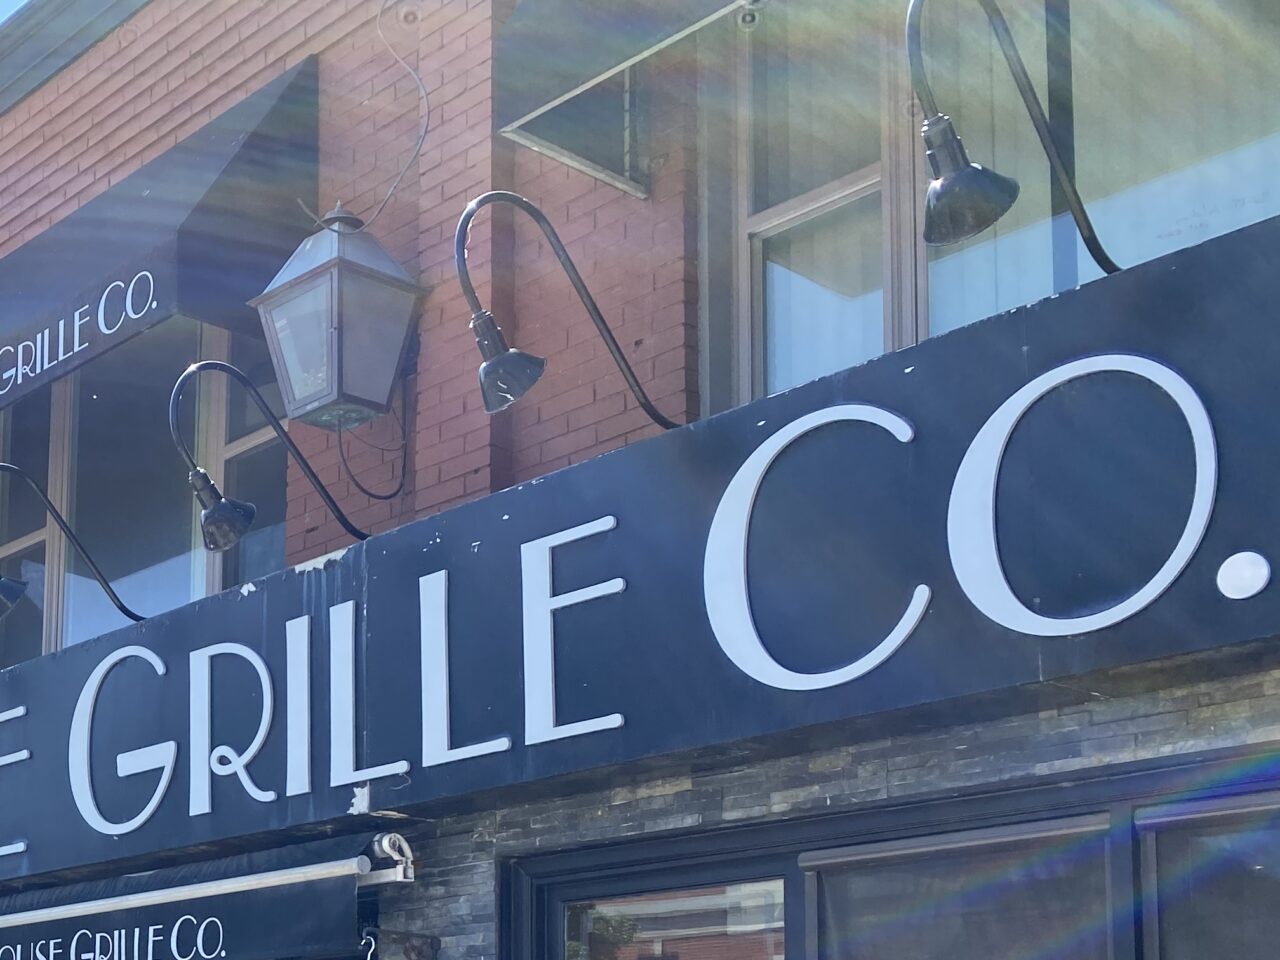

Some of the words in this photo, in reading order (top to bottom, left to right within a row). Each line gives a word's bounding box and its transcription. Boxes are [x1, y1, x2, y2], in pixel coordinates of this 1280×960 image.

[97, 270, 158, 335] CO.
[69, 514, 627, 837] GRILLE
[703, 352, 1273, 693] CO.
